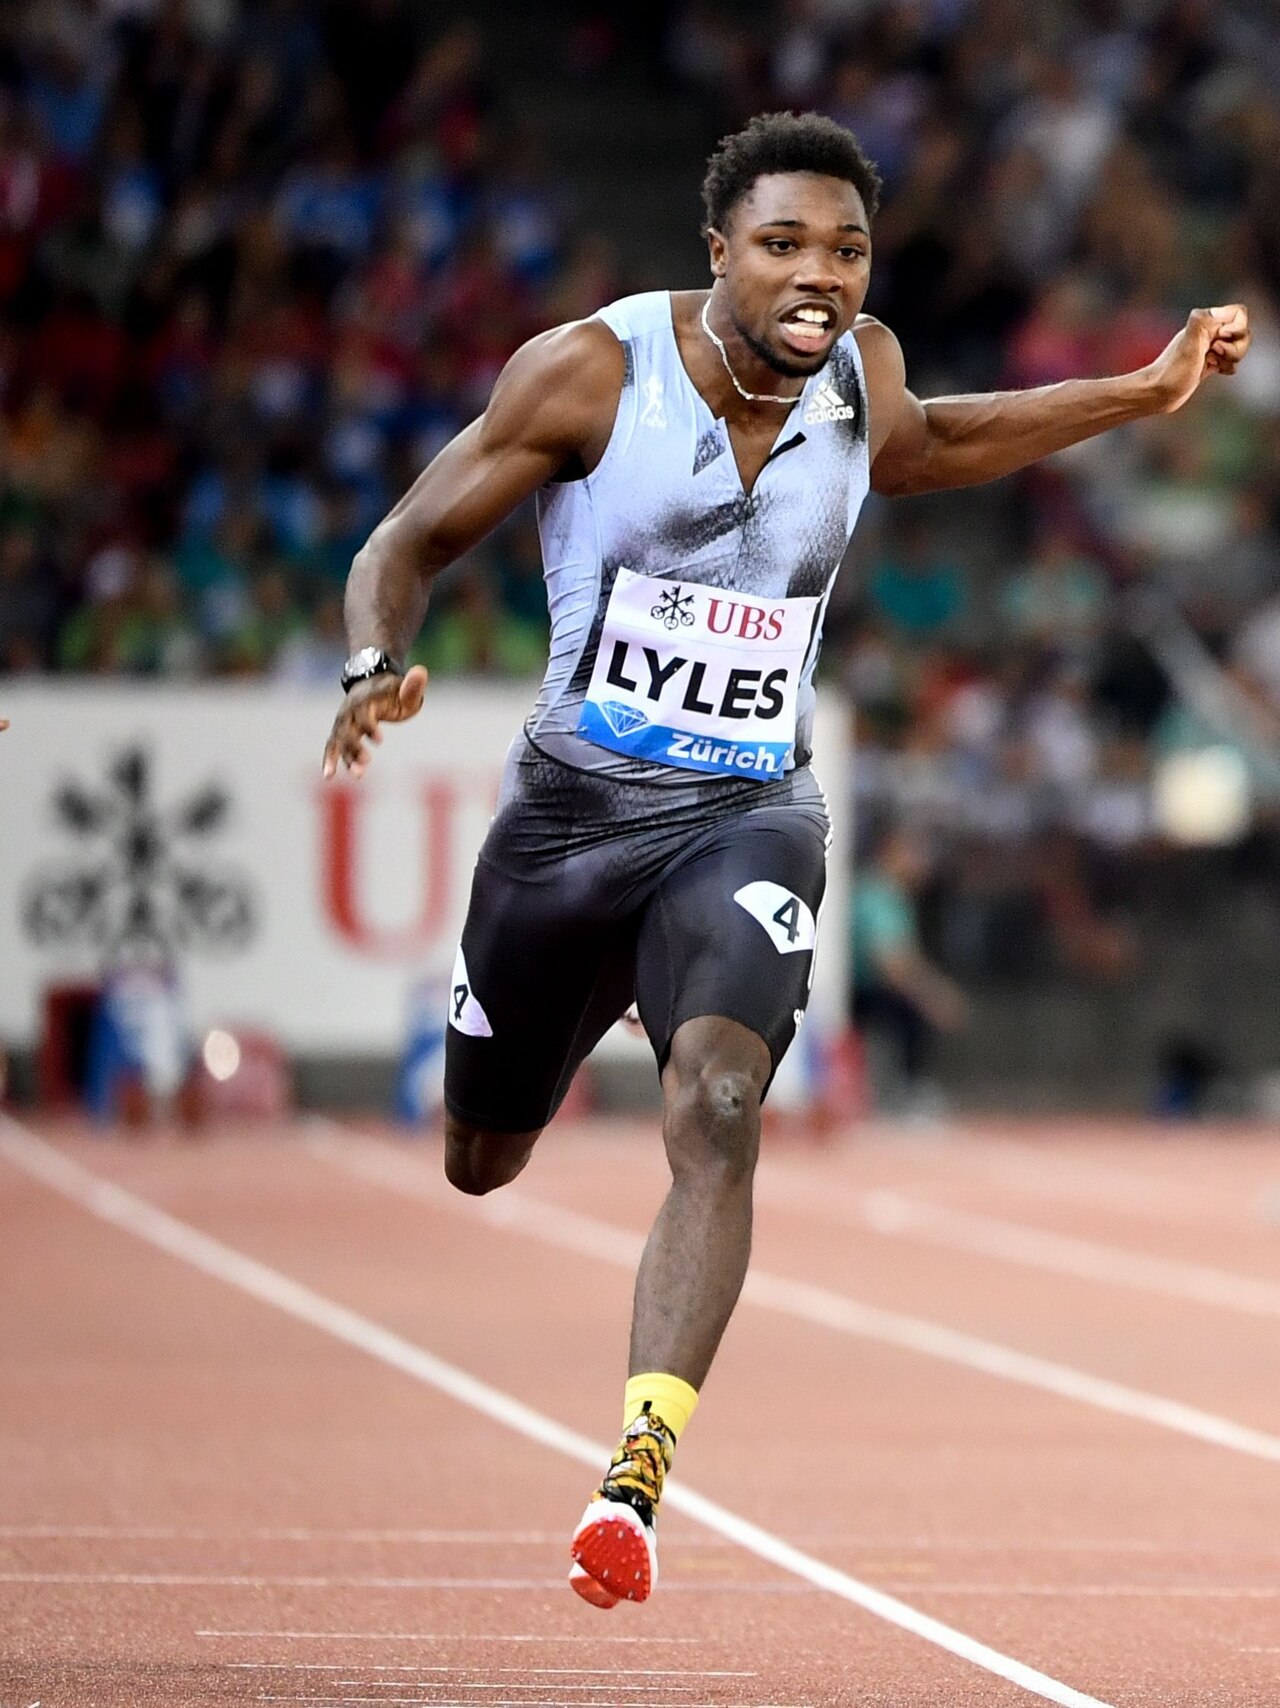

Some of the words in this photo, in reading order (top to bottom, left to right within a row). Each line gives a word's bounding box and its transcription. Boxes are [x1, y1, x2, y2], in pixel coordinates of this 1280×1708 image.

[804, 404, 855, 425] adidas
[707, 597, 785, 641] UBS
[606, 639, 789, 720] LYLES
[666, 732, 777, 773] Zürich
[772, 896, 801, 944] 4
[453, 983, 470, 1021] 4
